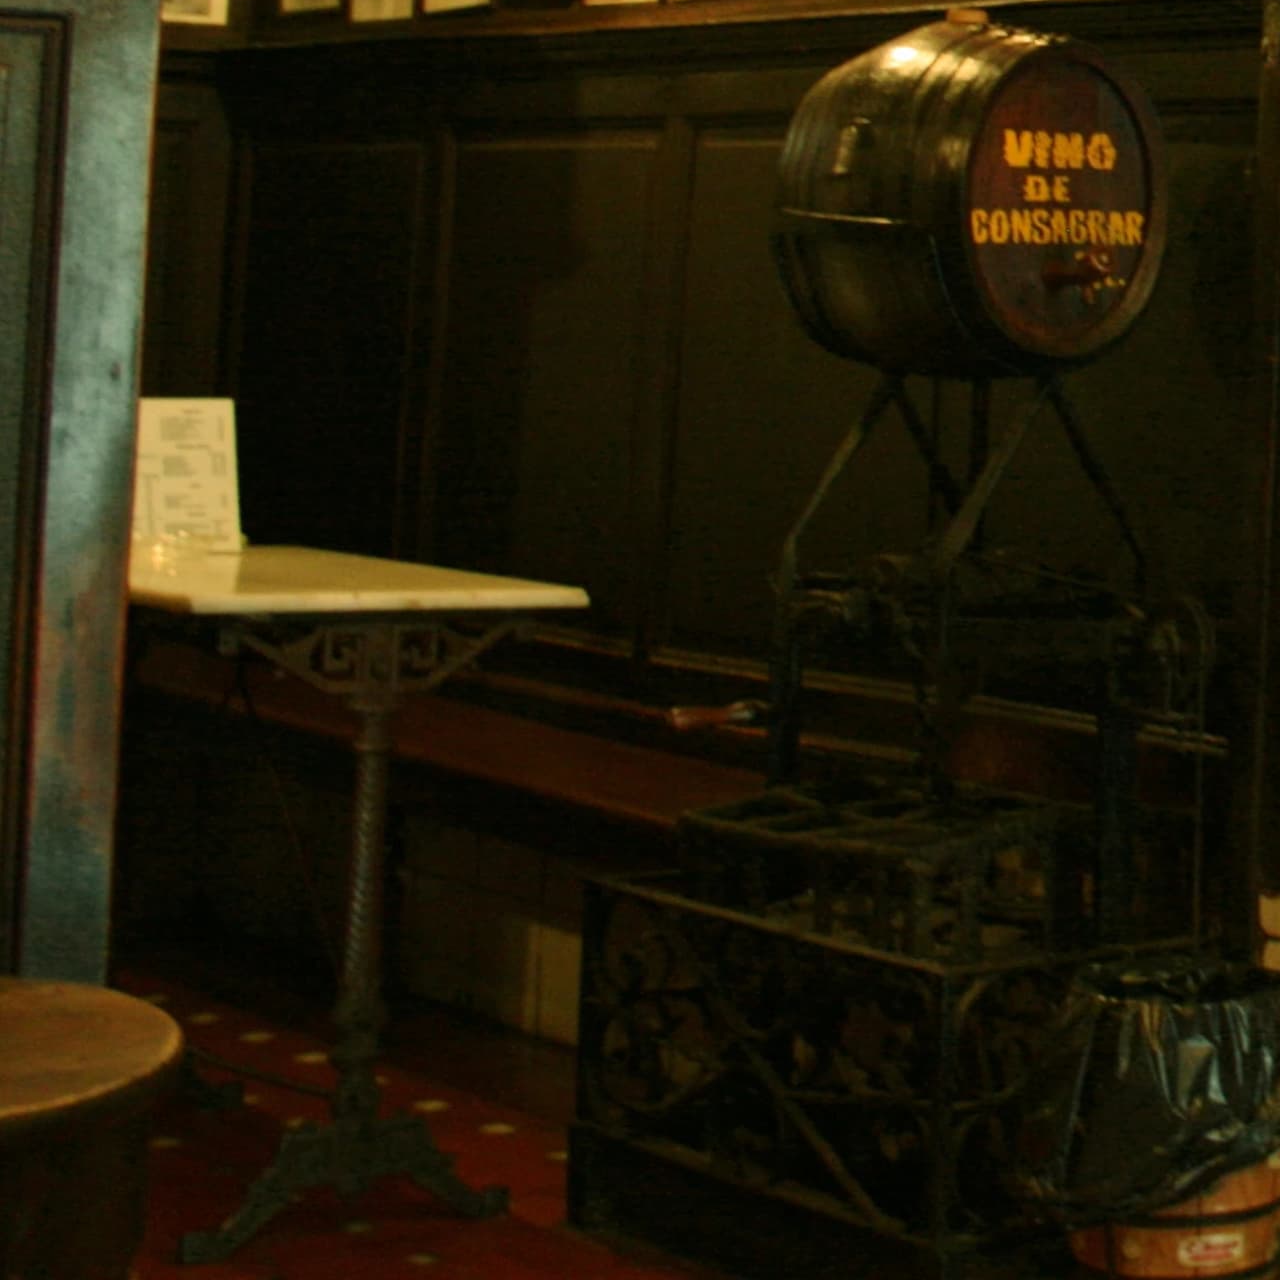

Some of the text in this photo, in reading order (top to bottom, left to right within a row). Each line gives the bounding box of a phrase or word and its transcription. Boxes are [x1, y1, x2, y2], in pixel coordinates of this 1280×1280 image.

[1003, 128, 1117, 170] VINO
[1023, 175, 1071, 203] DE
[971, 208, 1145, 246] CONSAGRAR
